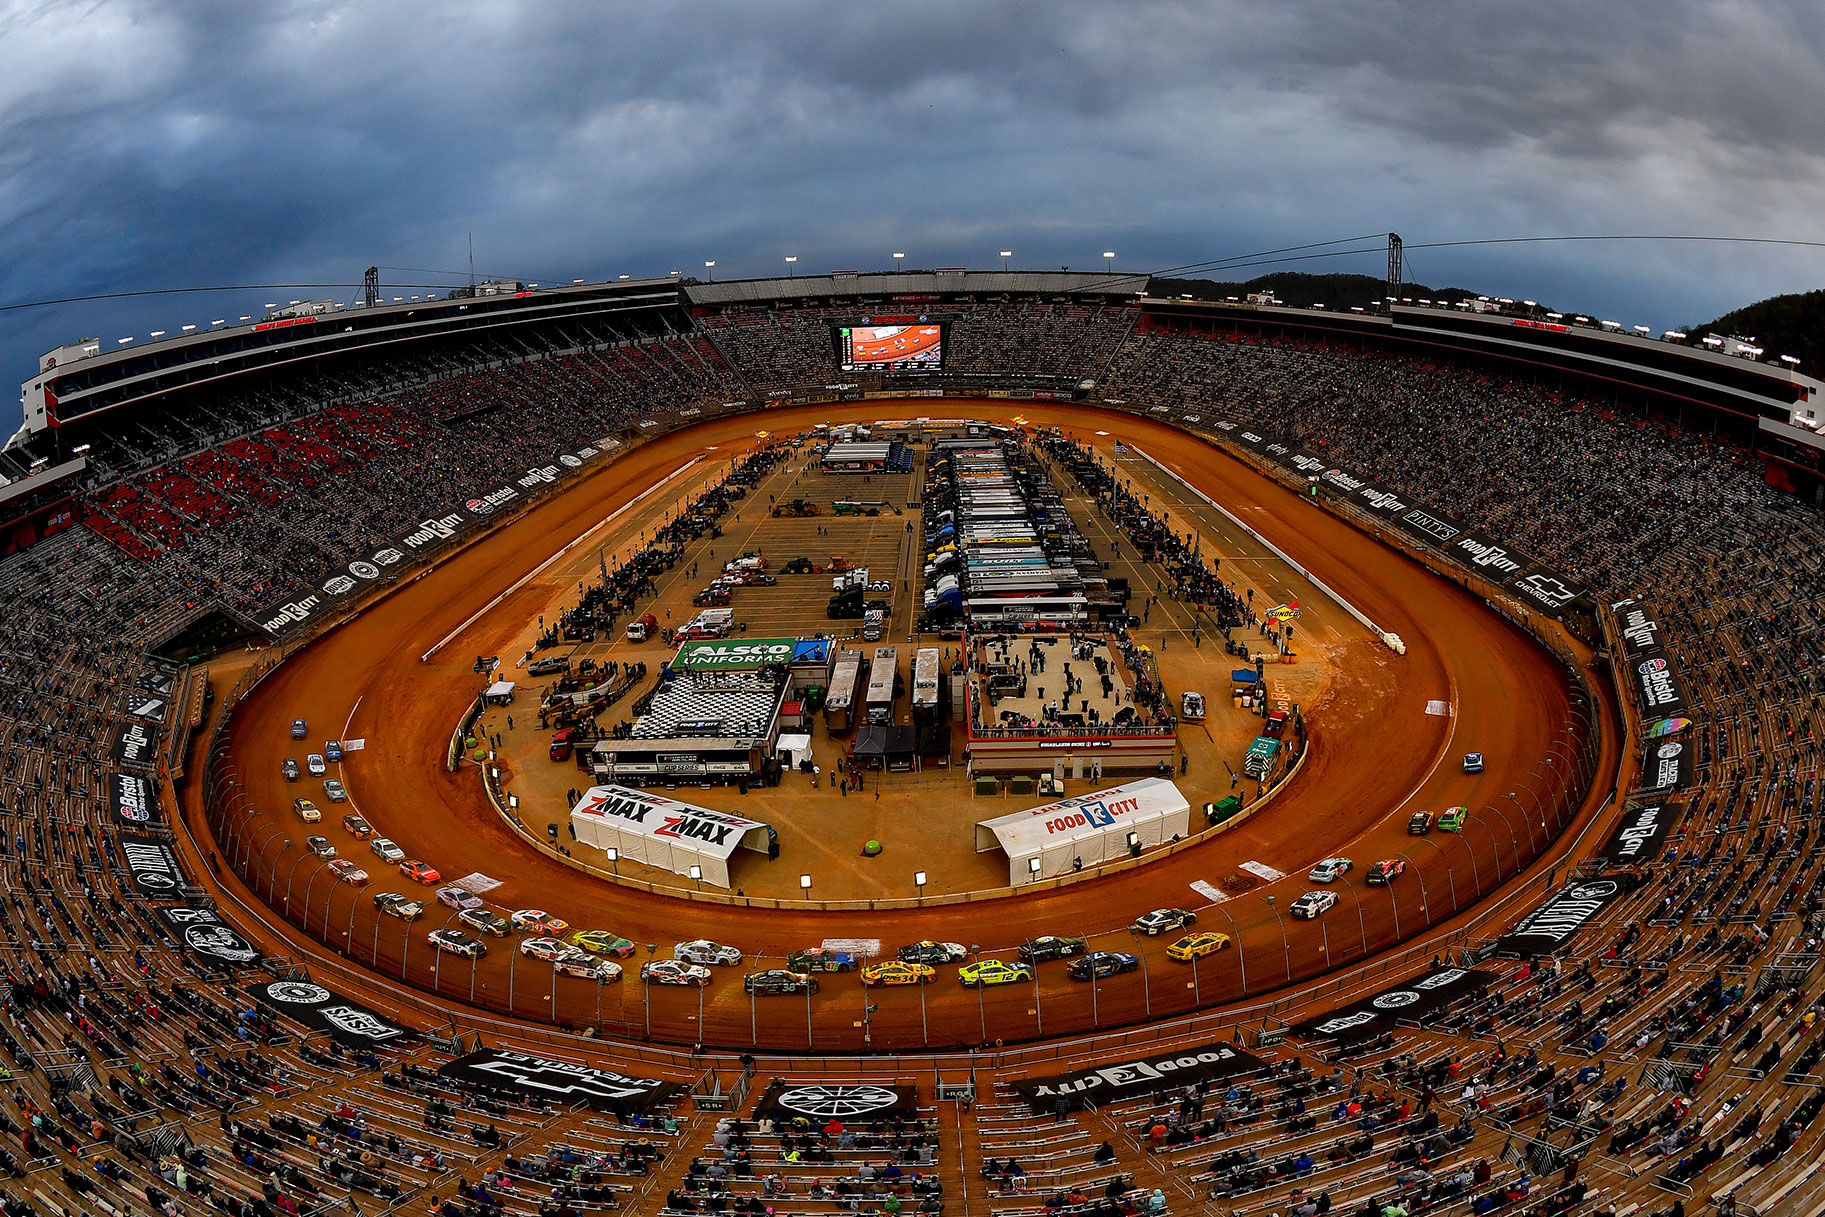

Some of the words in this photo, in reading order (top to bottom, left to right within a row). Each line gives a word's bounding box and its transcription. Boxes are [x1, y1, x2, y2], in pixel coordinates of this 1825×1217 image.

[1240, 431, 1262, 443] GEICO
[1290, 454, 1309, 463] FOOD
[517, 474, 541, 488] FOOD
[542, 464, 561, 476] CITY
[1335, 472, 1366, 489] Bristol
[483, 485, 515, 504] Bristol
[1360, 488, 1382, 500] FOOD
[1384, 500, 1407, 511] CITY
[403, 529, 434, 548] FOOD
[439, 512, 465, 528] CITY
[1407, 511, 1454, 538] PINTY'S
[1457, 538, 1487, 555] FOOD
[1491, 557, 1520, 572] CITY
[1514, 580, 1560, 609] CHEVROLET
[263, 612, 291, 633] FOOD
[298, 594, 320, 610] CITY
[1626, 610, 1646, 626] FOOD
[1634, 632, 1654, 647] CITY
[683, 654, 785, 665] UNIFORMS
[688, 644, 788, 656] ALSCO
[1650, 669, 1679, 704] Bristol
[130, 724, 144, 737] CITY
[124, 743, 139, 759] FOOD
[118, 773, 138, 807] Bristol
[581, 795, 654, 823] ZMAX
[1045, 812, 1086, 835] FOOD
[1107, 797, 1140, 816] CITY
[1636, 807, 1660, 826] FOOD
[654, 814, 735, 847] ZMAX
[1618, 838, 1643, 856] CITY
[123, 841, 171, 873] HENRY
[170, 908, 204, 922] 50
[1515, 900, 1604, 942] HENRY
[534, 923, 543, 932] 43
[940, 953, 950, 961] 31
[586, 969, 594, 977] 2
[825, 963, 835, 971] 47
[901, 974, 913, 982] 34
[1001, 973, 1013, 981] 12
[782, 983, 795, 992] 38
[493, 1050, 663, 1087] CHEVROLET
[1155, 1048, 1236, 1072] FOOD
[1035, 1075, 1103, 1097] CITY
